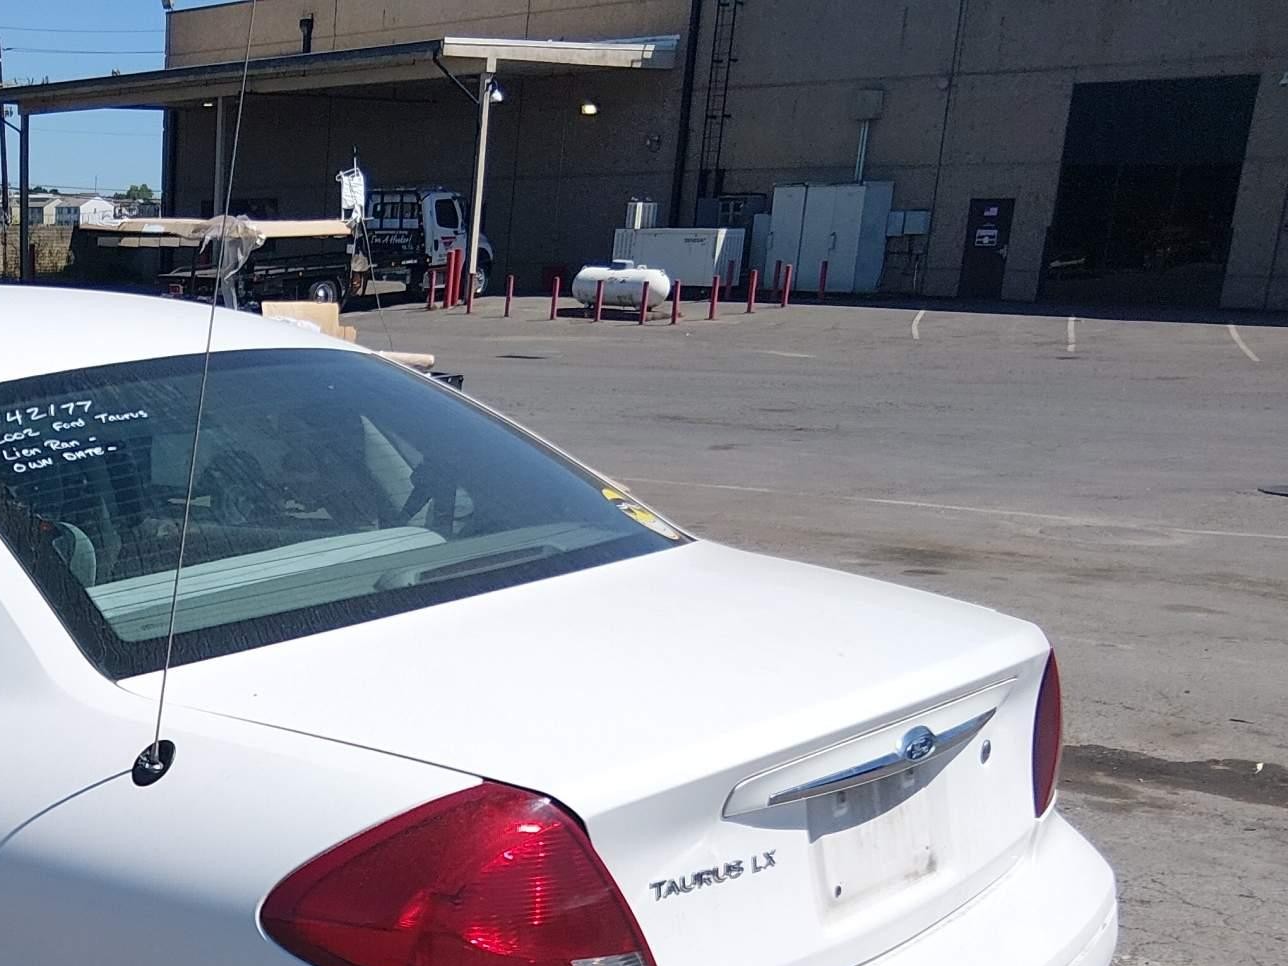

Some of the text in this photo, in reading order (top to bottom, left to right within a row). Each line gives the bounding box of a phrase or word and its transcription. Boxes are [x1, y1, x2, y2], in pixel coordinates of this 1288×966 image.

[52, 418, 86, 432] Ford
[94, 410, 149, 424] Taurus
[2, 447, 42, 461] Lien
[649, 849, 777, 902] TAURUS LX
